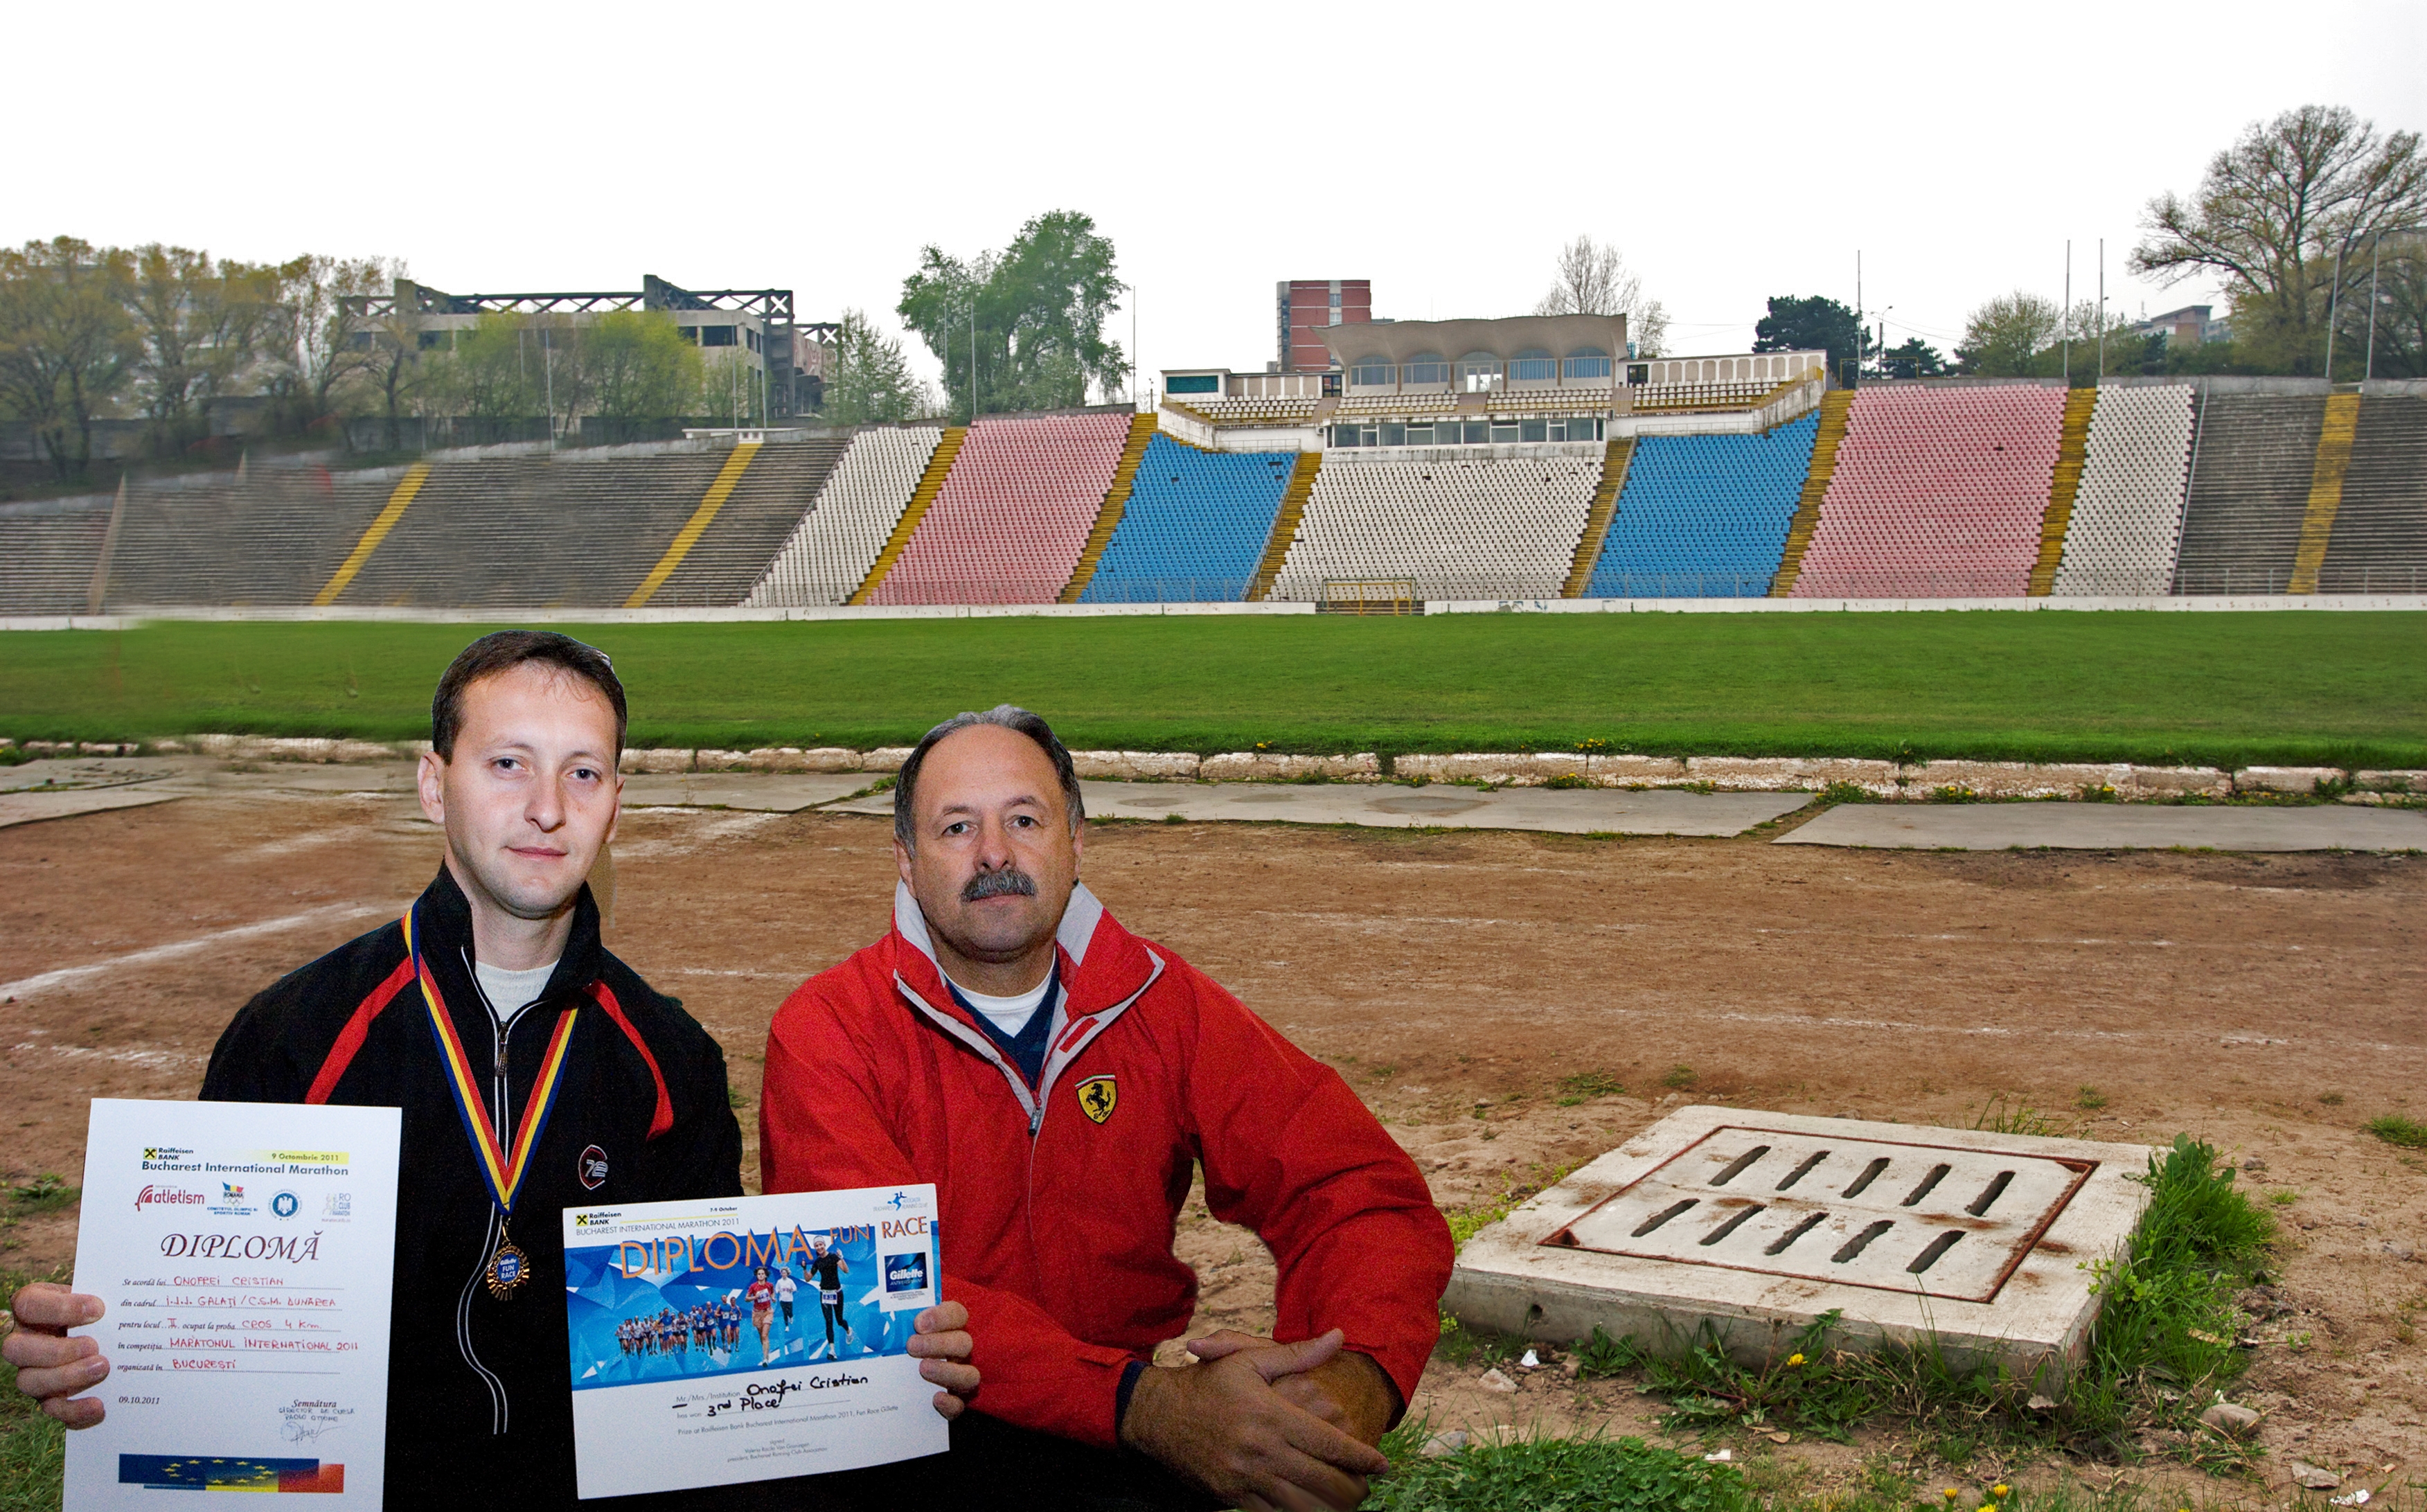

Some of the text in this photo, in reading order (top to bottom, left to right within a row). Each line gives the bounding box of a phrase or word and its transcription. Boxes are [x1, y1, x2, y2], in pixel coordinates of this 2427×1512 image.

[142, 1161, 348, 1175] Bucharest International Marathon
[154, 1189, 204, 1204] atletism
[339, 1193, 351, 1202] RO
[576, 1227, 617, 1236] BUCHAREST
[619, 1221, 677, 1233] INTERNATIONAL
[678, 1220, 720, 1229] MARATHON
[161, 1230, 323, 1263] DIPLOMĂ
[620, 1216, 928, 1279] DIPLOMA FUN RACE
[890, 1269, 923, 1281] Gillette
[118, 1322, 141, 1330] pentru
[183, 1322, 206, 1331] ocupat
[215, 1322, 235, 1331] proba
[285, 1319, 292, 1328] 4
[337, 1342, 358, 1351] 2011
[118, 1363, 154, 1372] organizată
[810, 1373, 868, 1389] Cristian
[292, 1399, 337, 1408] Semnătura
[740, 1396, 780, 1412] Place
[702, 1425, 729, 1433] Raiffeisen
[774, 1416, 808, 1425] International
